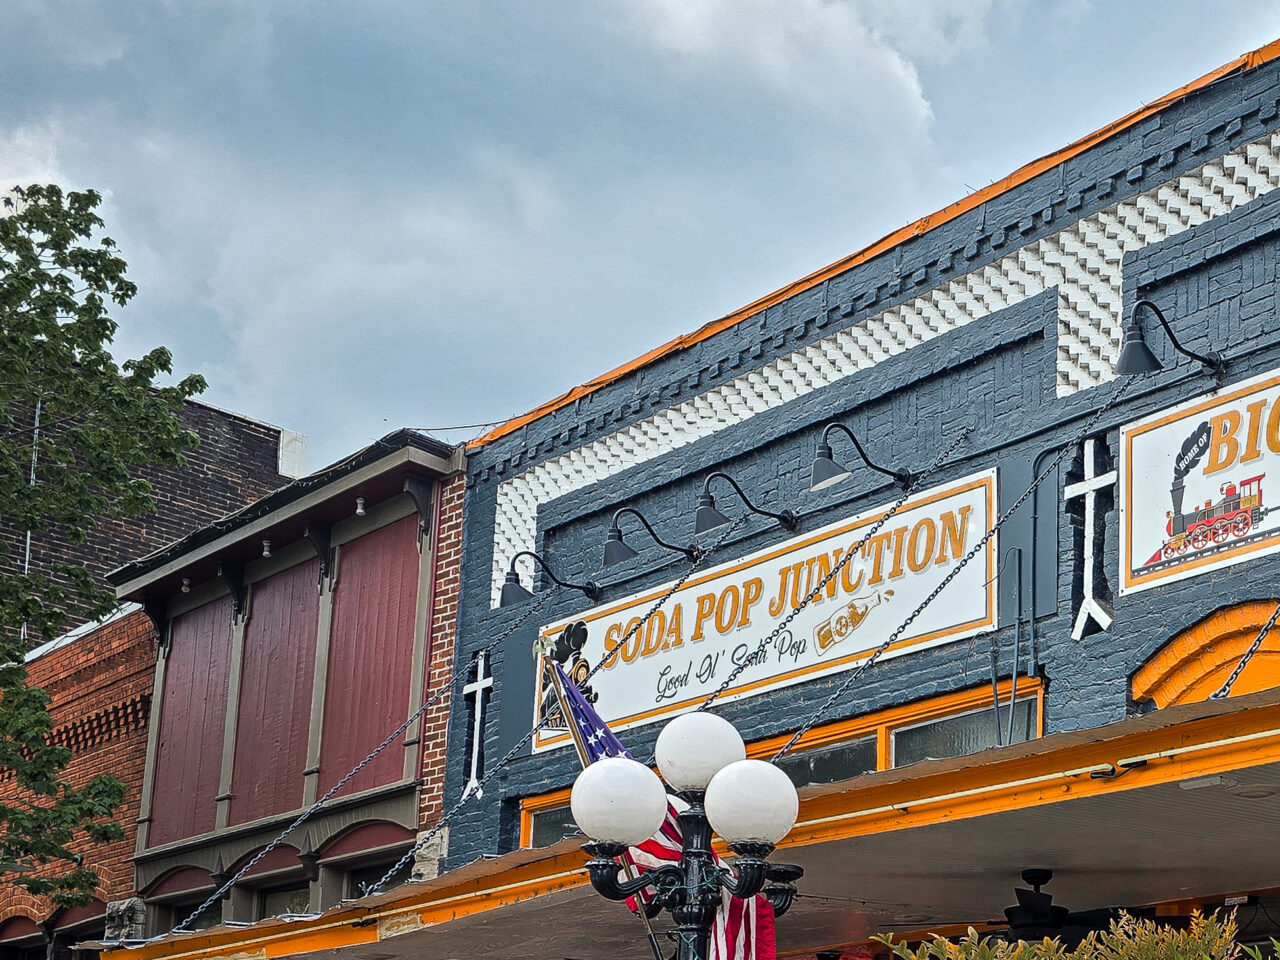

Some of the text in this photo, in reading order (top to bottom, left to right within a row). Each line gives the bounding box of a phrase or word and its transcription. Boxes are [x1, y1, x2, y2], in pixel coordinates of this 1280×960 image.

[1179, 433, 1208, 471] HOME OF
[602, 504, 972, 669] SODA POP JUNCTION
[656, 661, 692, 703] Good
[773, 630, 808, 663] Pop
